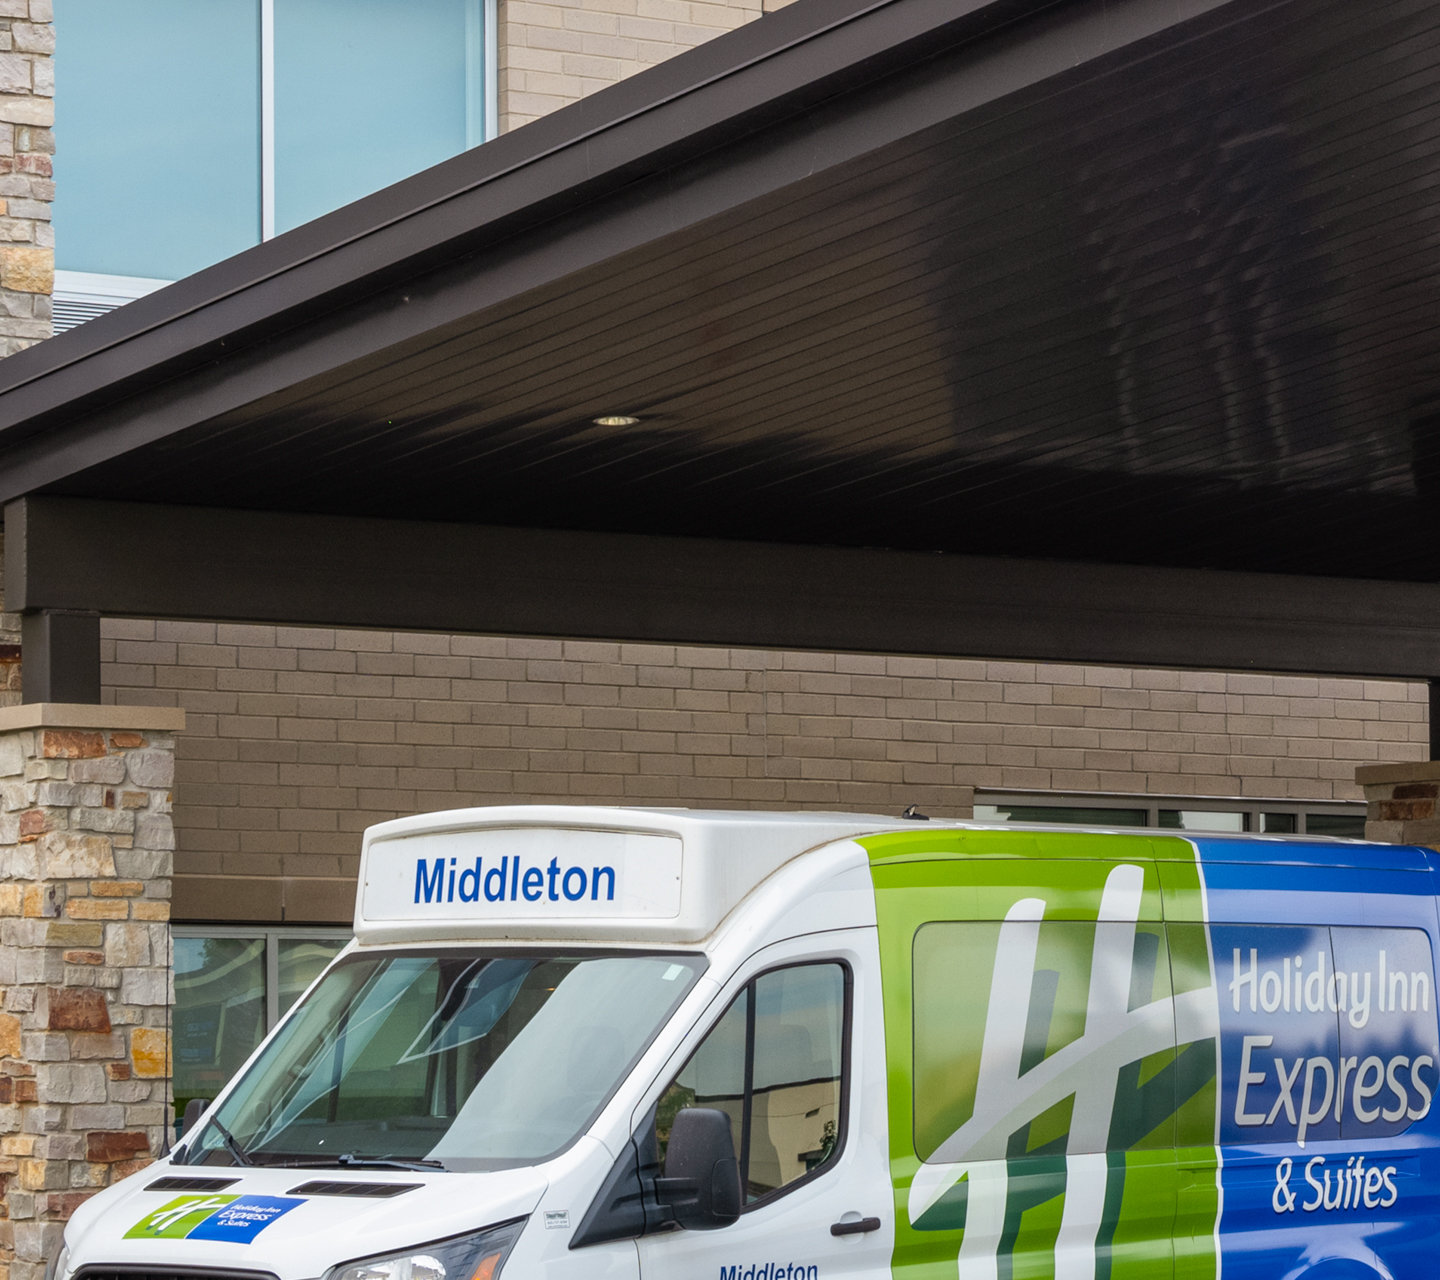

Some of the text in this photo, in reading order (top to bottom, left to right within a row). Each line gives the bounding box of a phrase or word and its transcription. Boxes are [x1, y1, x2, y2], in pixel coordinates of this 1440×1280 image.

[413, 855, 616, 904] Middleton
[1228, 947, 1430, 1029] Holiday Inn
[1234, 1035, 1434, 1149] Express
[1272, 1155, 1398, 1213] & Suites
[218, 1209, 273, 1221] Express
[225, 1219, 252, 1227] Suites
